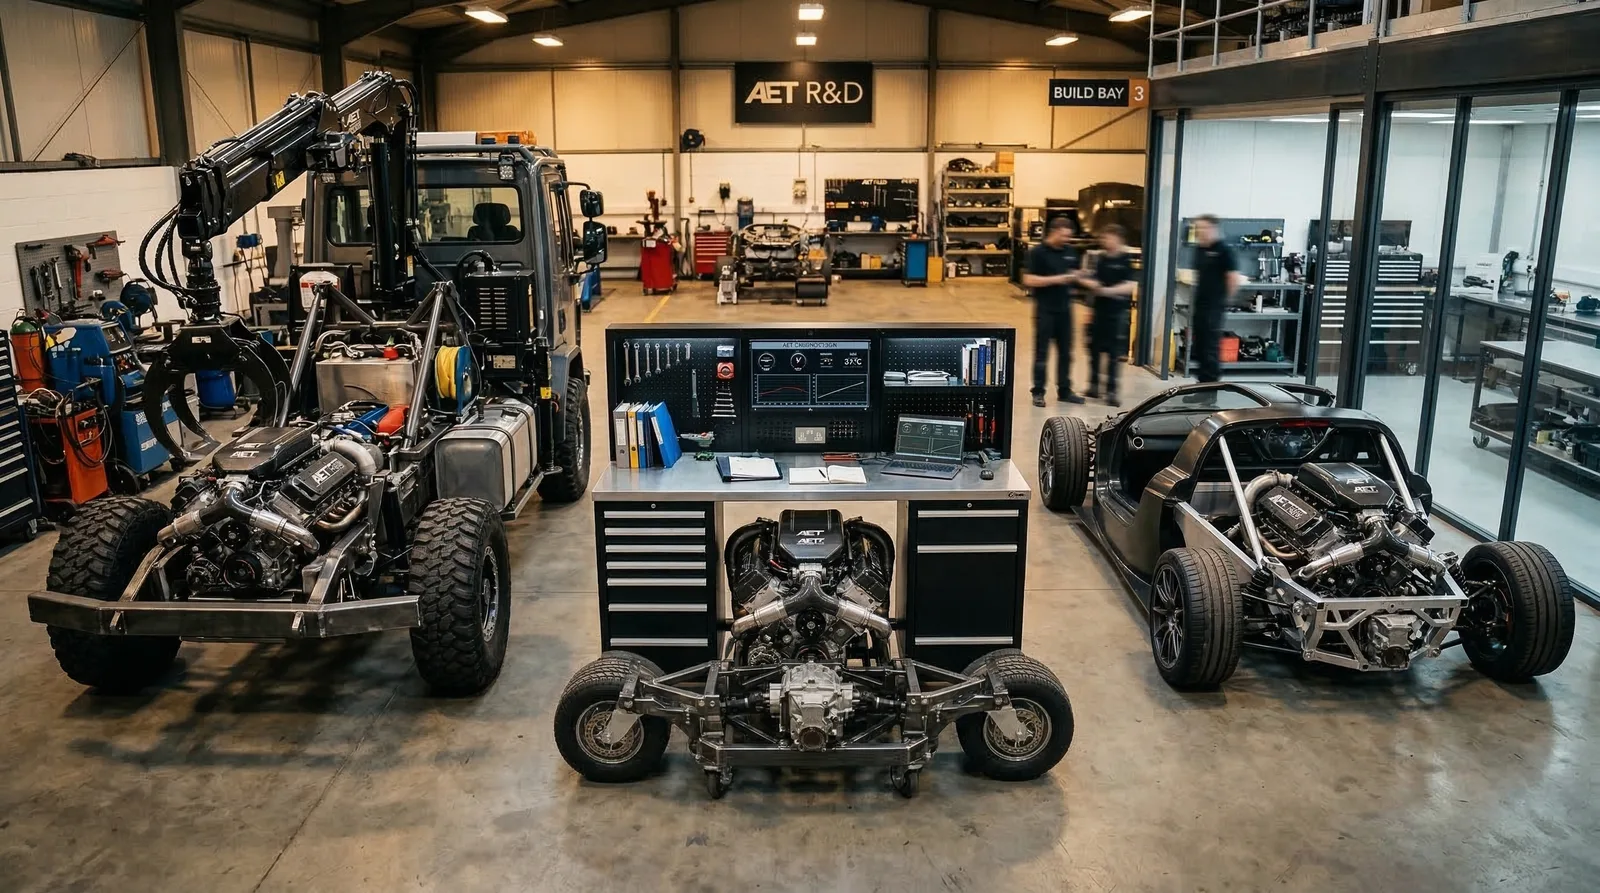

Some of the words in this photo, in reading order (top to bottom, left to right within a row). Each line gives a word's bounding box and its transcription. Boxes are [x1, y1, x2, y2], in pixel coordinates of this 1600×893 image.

[744, 81, 799, 104] AET
[806, 81, 863, 104] R&D
[1053, 86, 1094, 99] BUILD
[1098, 87, 1124, 99] BAY
[1134, 86, 1144, 101] 3
[229, 450, 260, 458] AET
